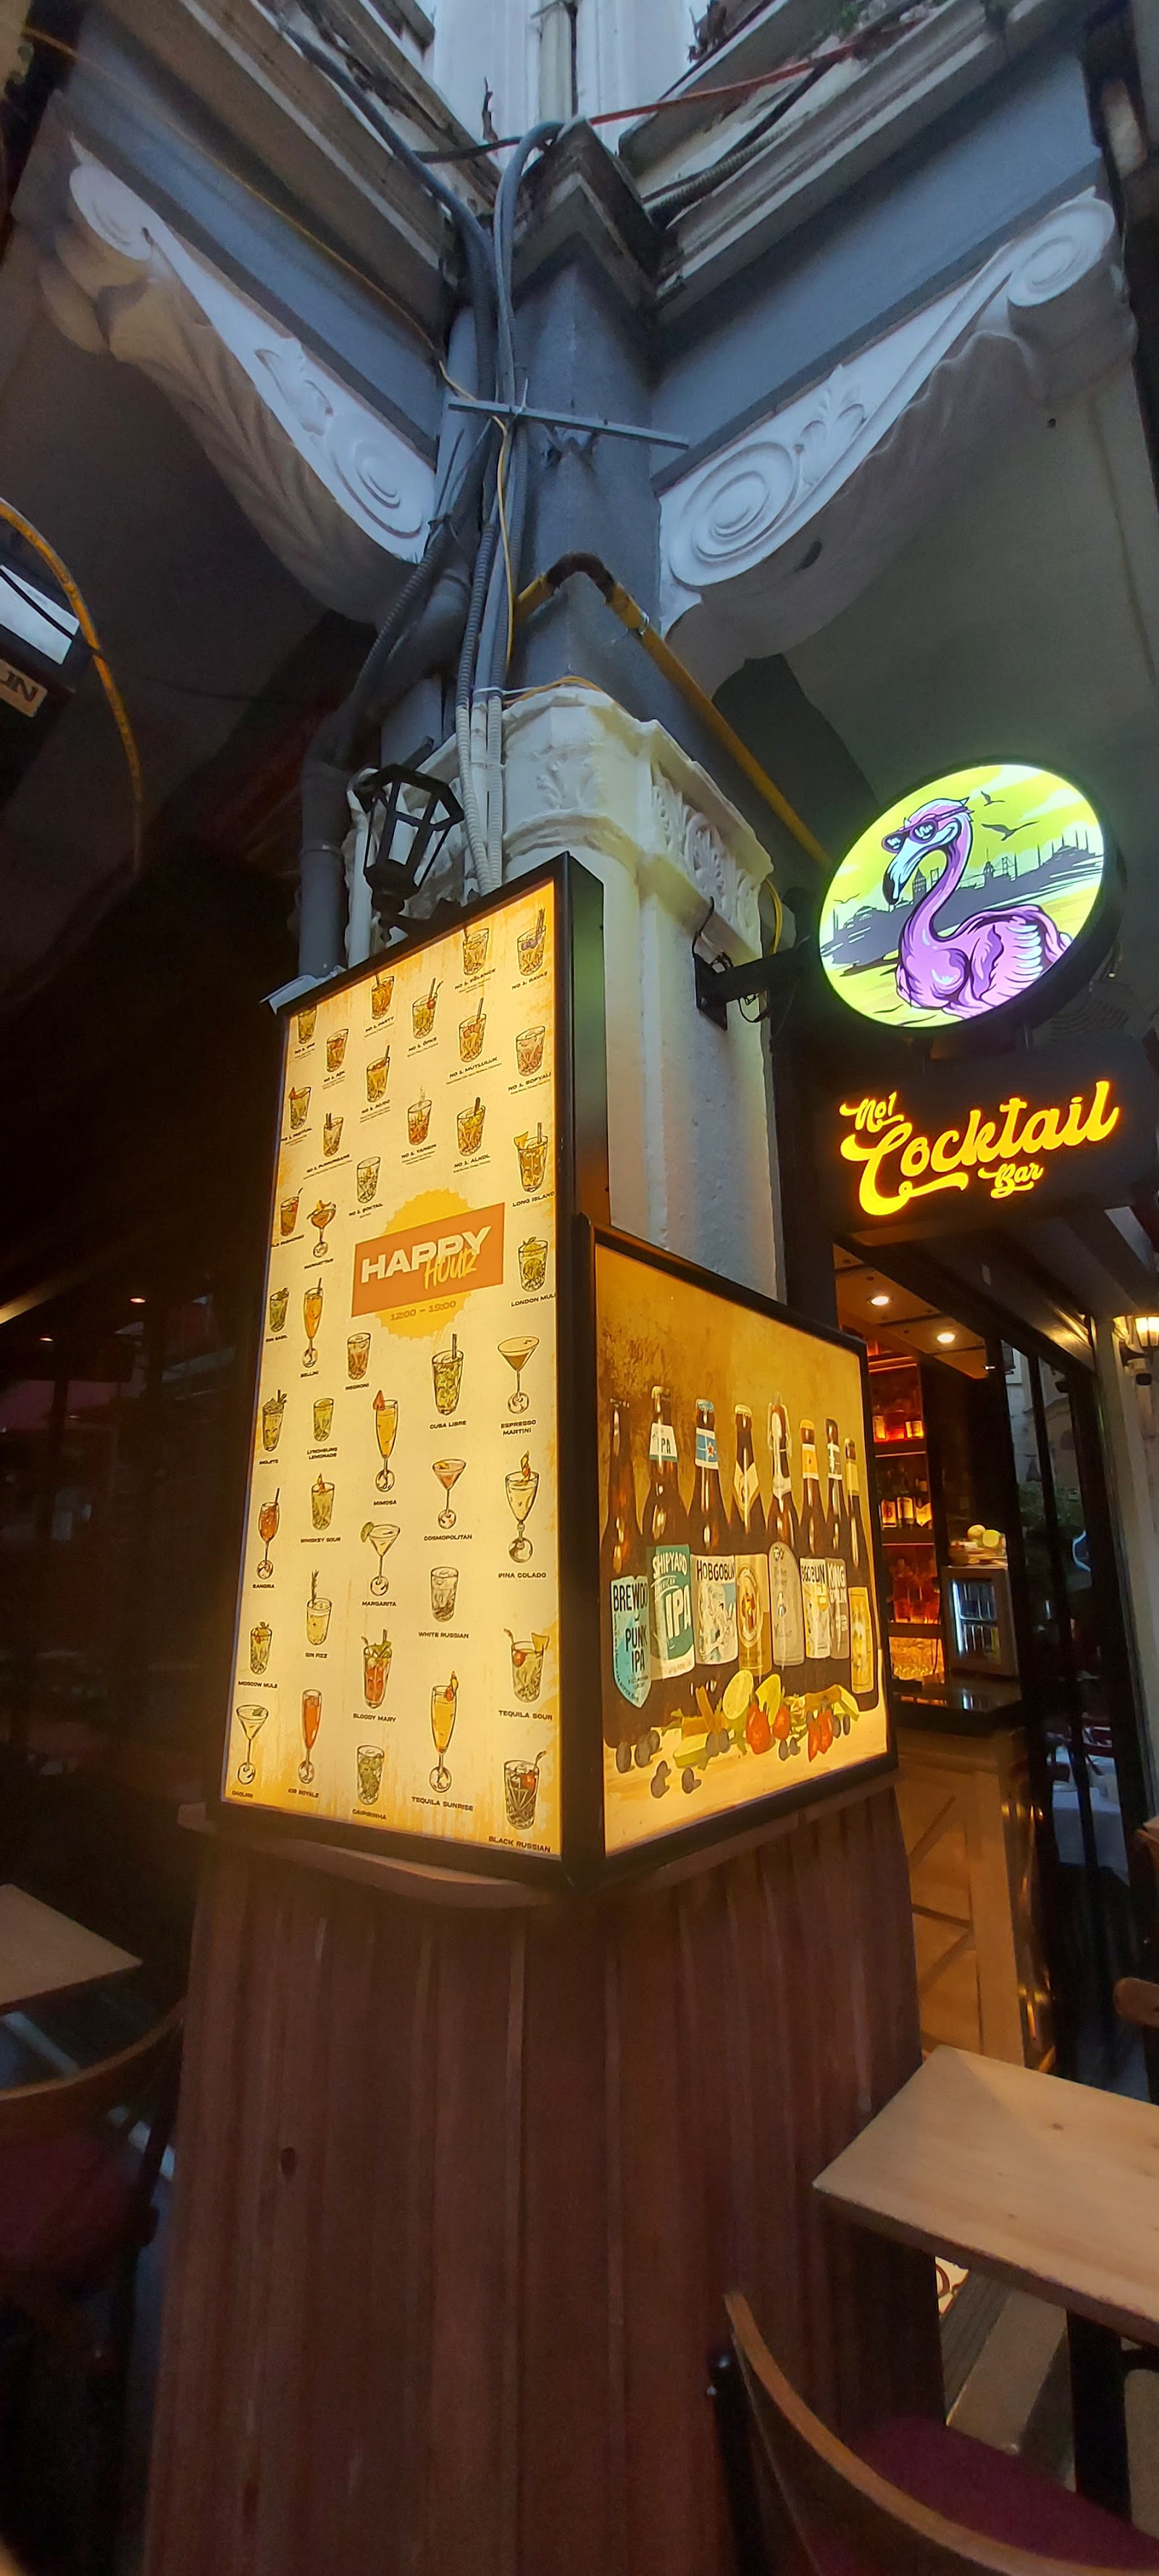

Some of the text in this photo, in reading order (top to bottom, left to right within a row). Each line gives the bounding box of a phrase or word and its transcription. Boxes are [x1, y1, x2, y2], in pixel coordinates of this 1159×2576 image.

[464, 1056, 498, 1071] MUTLULUK
[471, 1154, 490, 1163] ALKOL
[840, 1080, 1121, 1216] Cocktail
[978, 1162, 1045, 1200] Bar
[512, 1191, 555, 1207] LONG ISLAND
[361, 1225, 492, 1284] HAPPY
[424, 1247, 477, 1290] HOUR
[511, 1297, 539, 1307] LONDON
[501, 1420, 536, 1429] ESPRESSO
[653, 1552, 688, 1580] SHIPYARD
[827, 1563, 845, 1589] KING
[665, 1584, 692, 1640] IPA
[625, 1624, 648, 1652] PUNK
[631, 1649, 645, 1674] IPA
[498, 1710, 553, 1721] TEQUILA SOUR
[411, 1796, 474, 1811] TEQUILA SUNRISE
[488, 1835, 551, 1852] BLACK RUSSIAN
